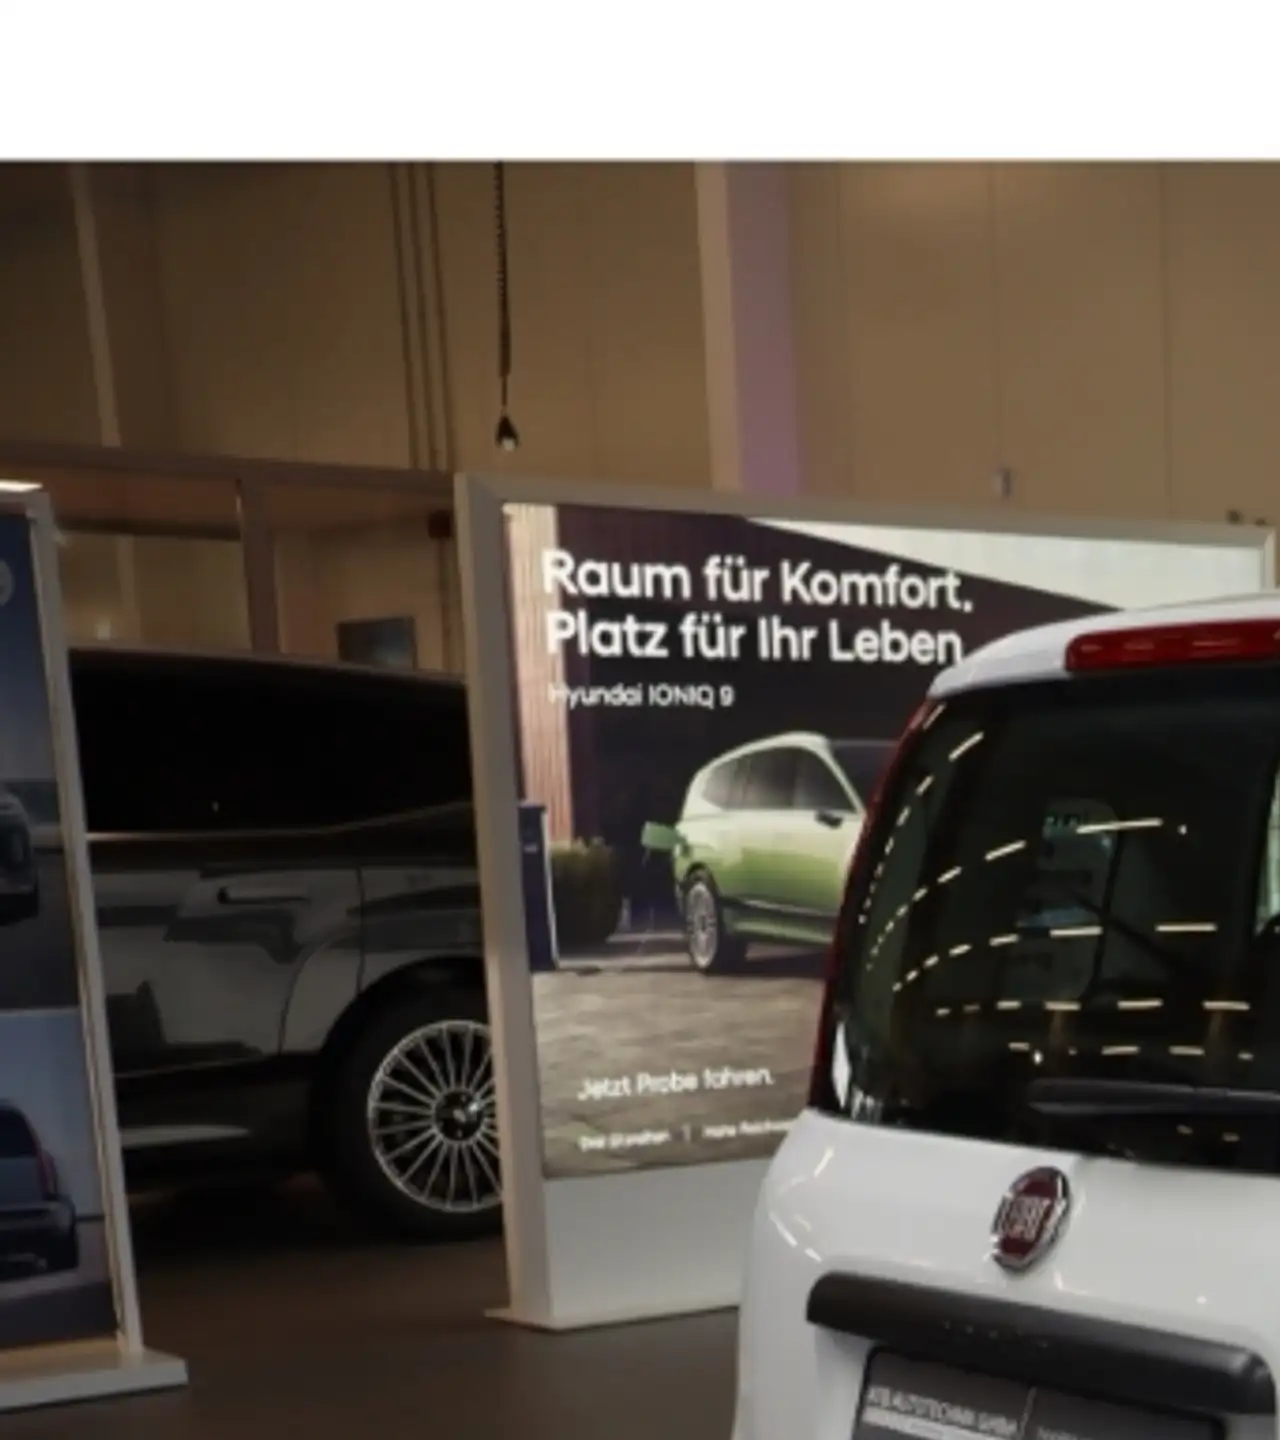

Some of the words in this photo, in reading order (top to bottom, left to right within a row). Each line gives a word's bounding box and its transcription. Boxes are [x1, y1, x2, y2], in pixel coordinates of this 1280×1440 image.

[541, 550, 692, 599] Raum
[703, 555, 770, 602] für
[780, 559, 974, 613] Komfort.
[546, 609, 669, 658] Platz
[679, 612, 747, 661] für
[757, 616, 817, 661] Ihr
[549, 681, 644, 708] Hyundai
[648, 684, 715, 708] IONIQ
[719, 684, 736, 707] 9
[577, 1076, 632, 1100] Jetzt
[637, 1071, 698, 1095] Probe
